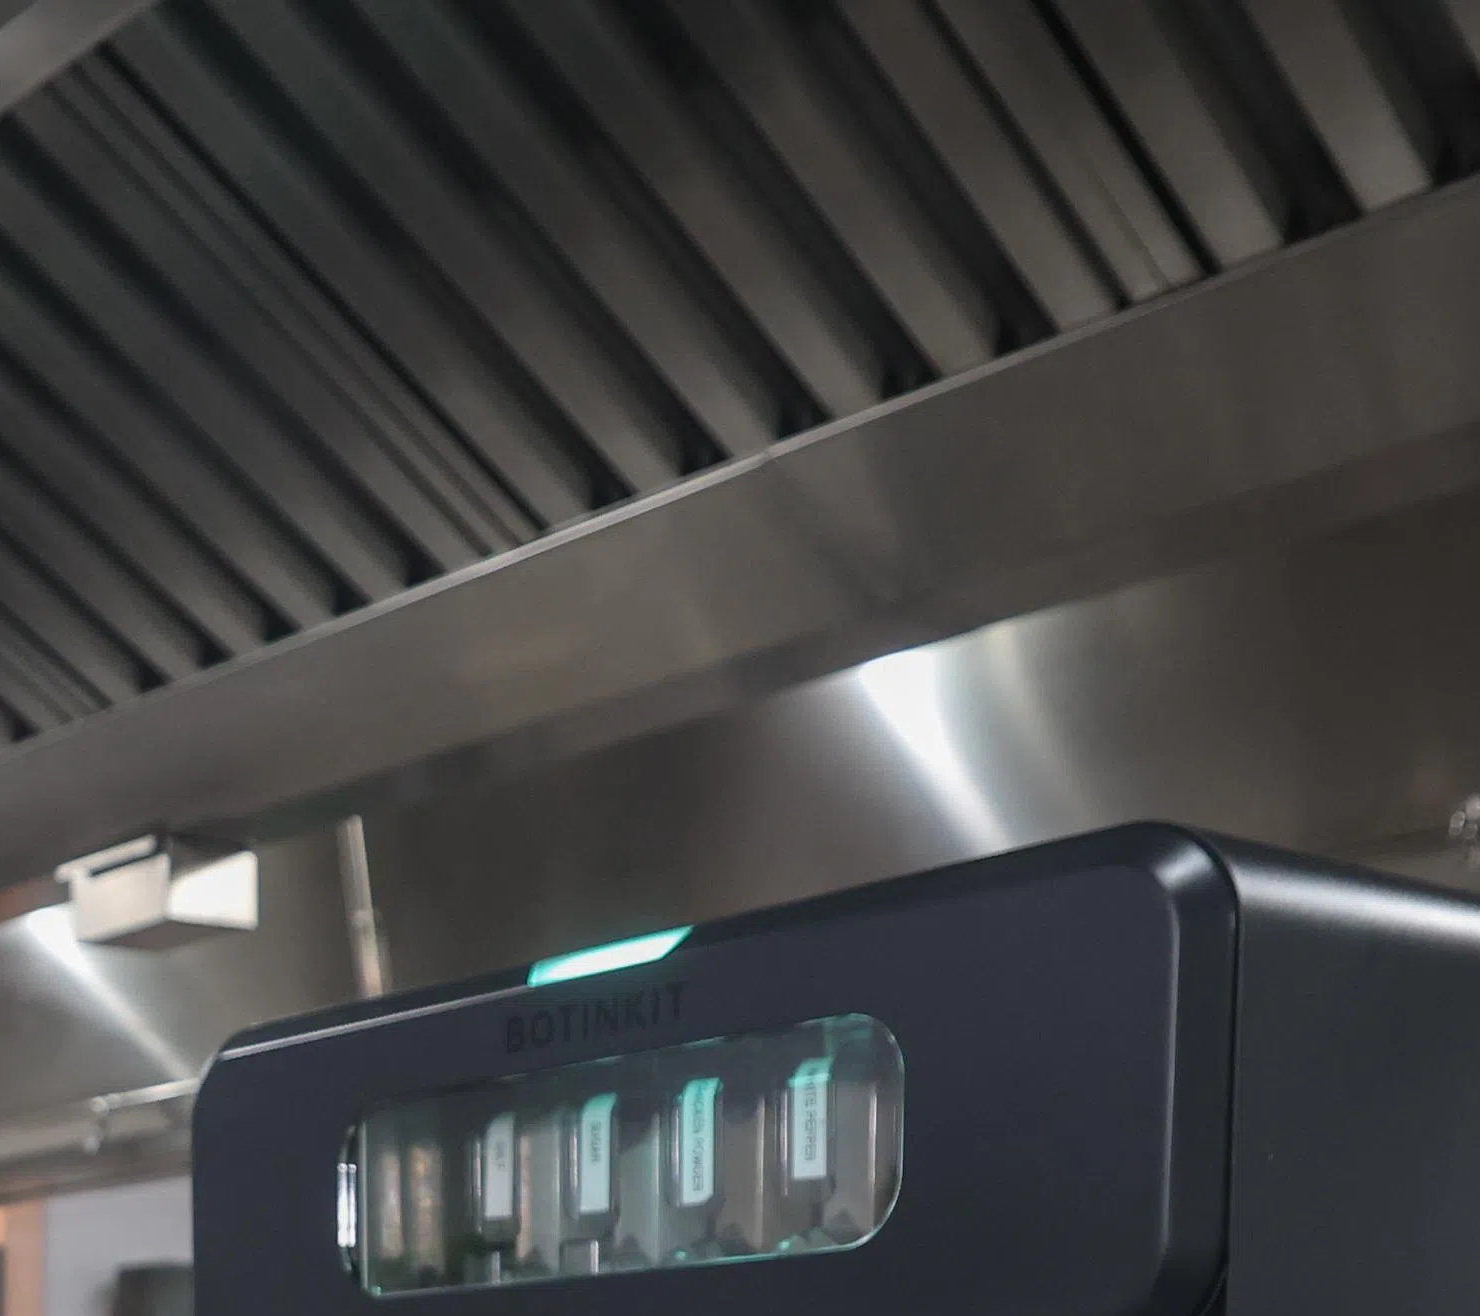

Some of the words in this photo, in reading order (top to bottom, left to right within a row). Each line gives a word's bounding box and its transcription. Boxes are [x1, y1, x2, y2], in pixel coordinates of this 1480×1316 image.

[505, 982, 683, 1052] BOTINKIT
[590, 1120, 602, 1163] SUGAR
[693, 1136, 704, 1192] POWDER
